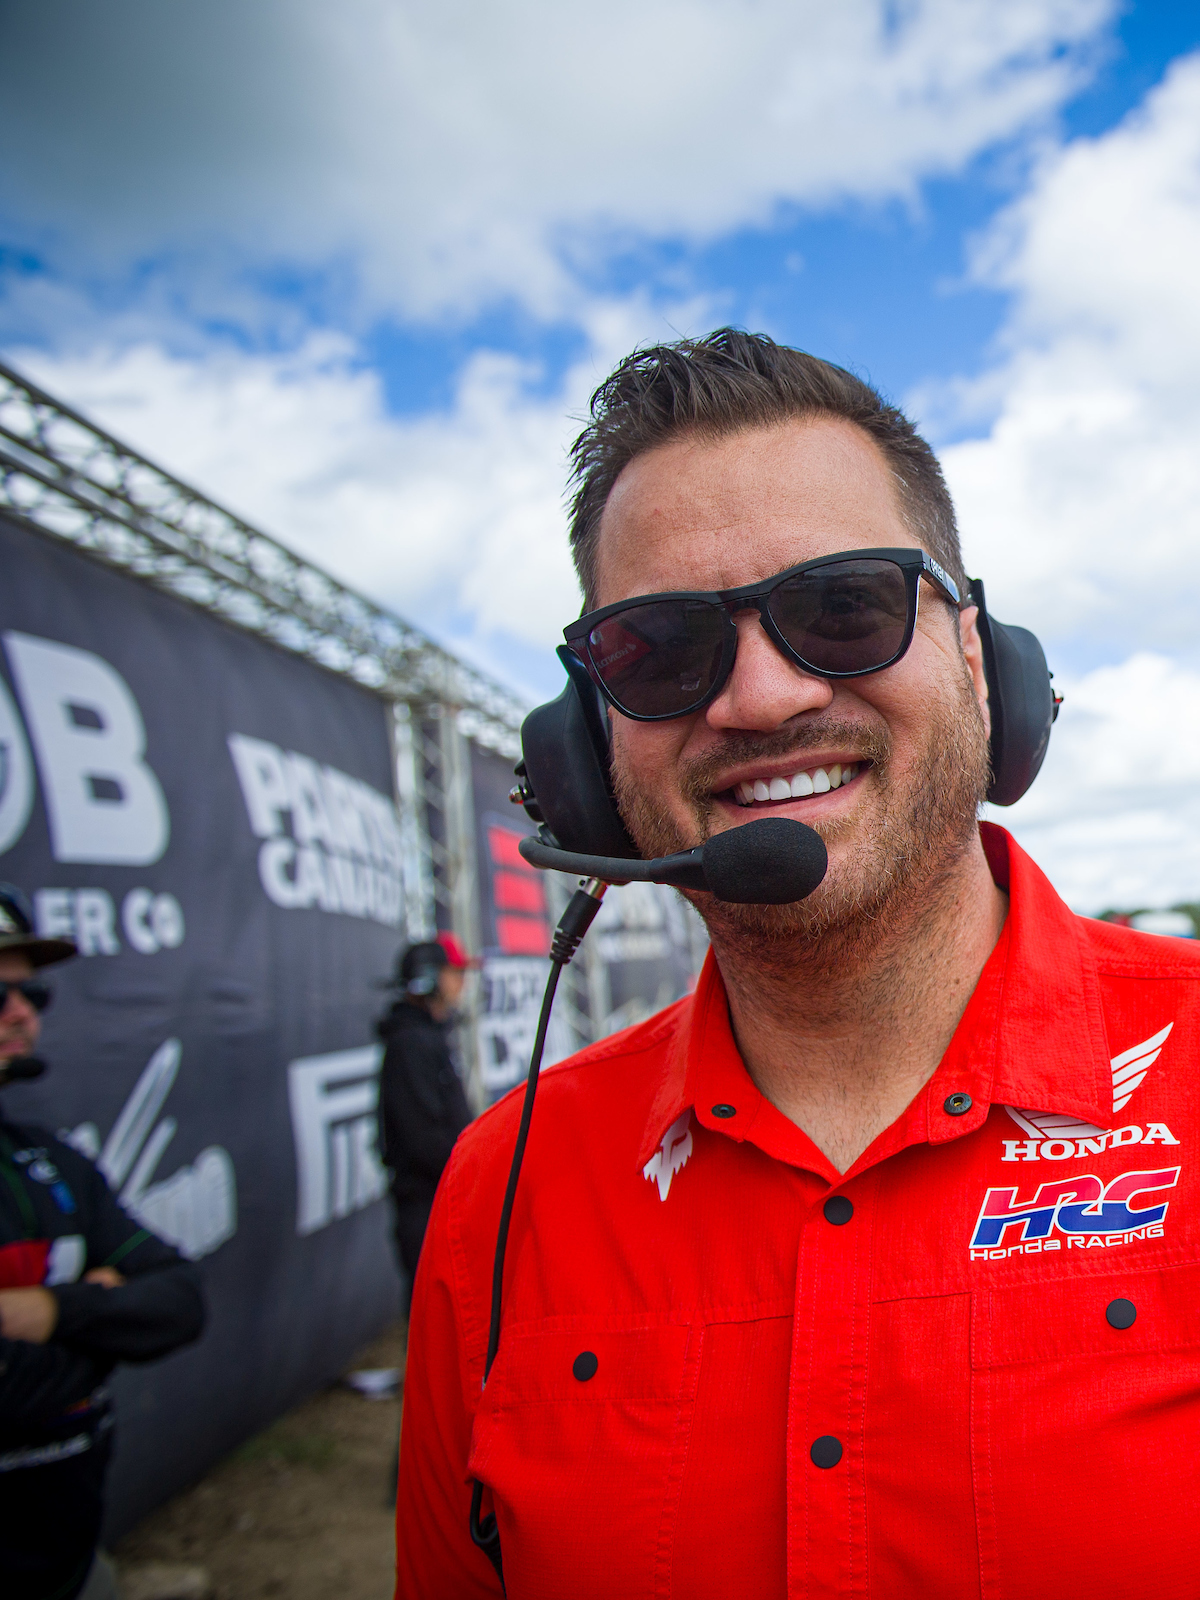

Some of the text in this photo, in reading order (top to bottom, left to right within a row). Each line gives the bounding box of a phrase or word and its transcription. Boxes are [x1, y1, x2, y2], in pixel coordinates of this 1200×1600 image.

[1001, 1123, 1180, 1161] HONDA
[969, 1166, 1181, 1249] HRC
[970, 1224, 1165, 1261] Honda RACING
